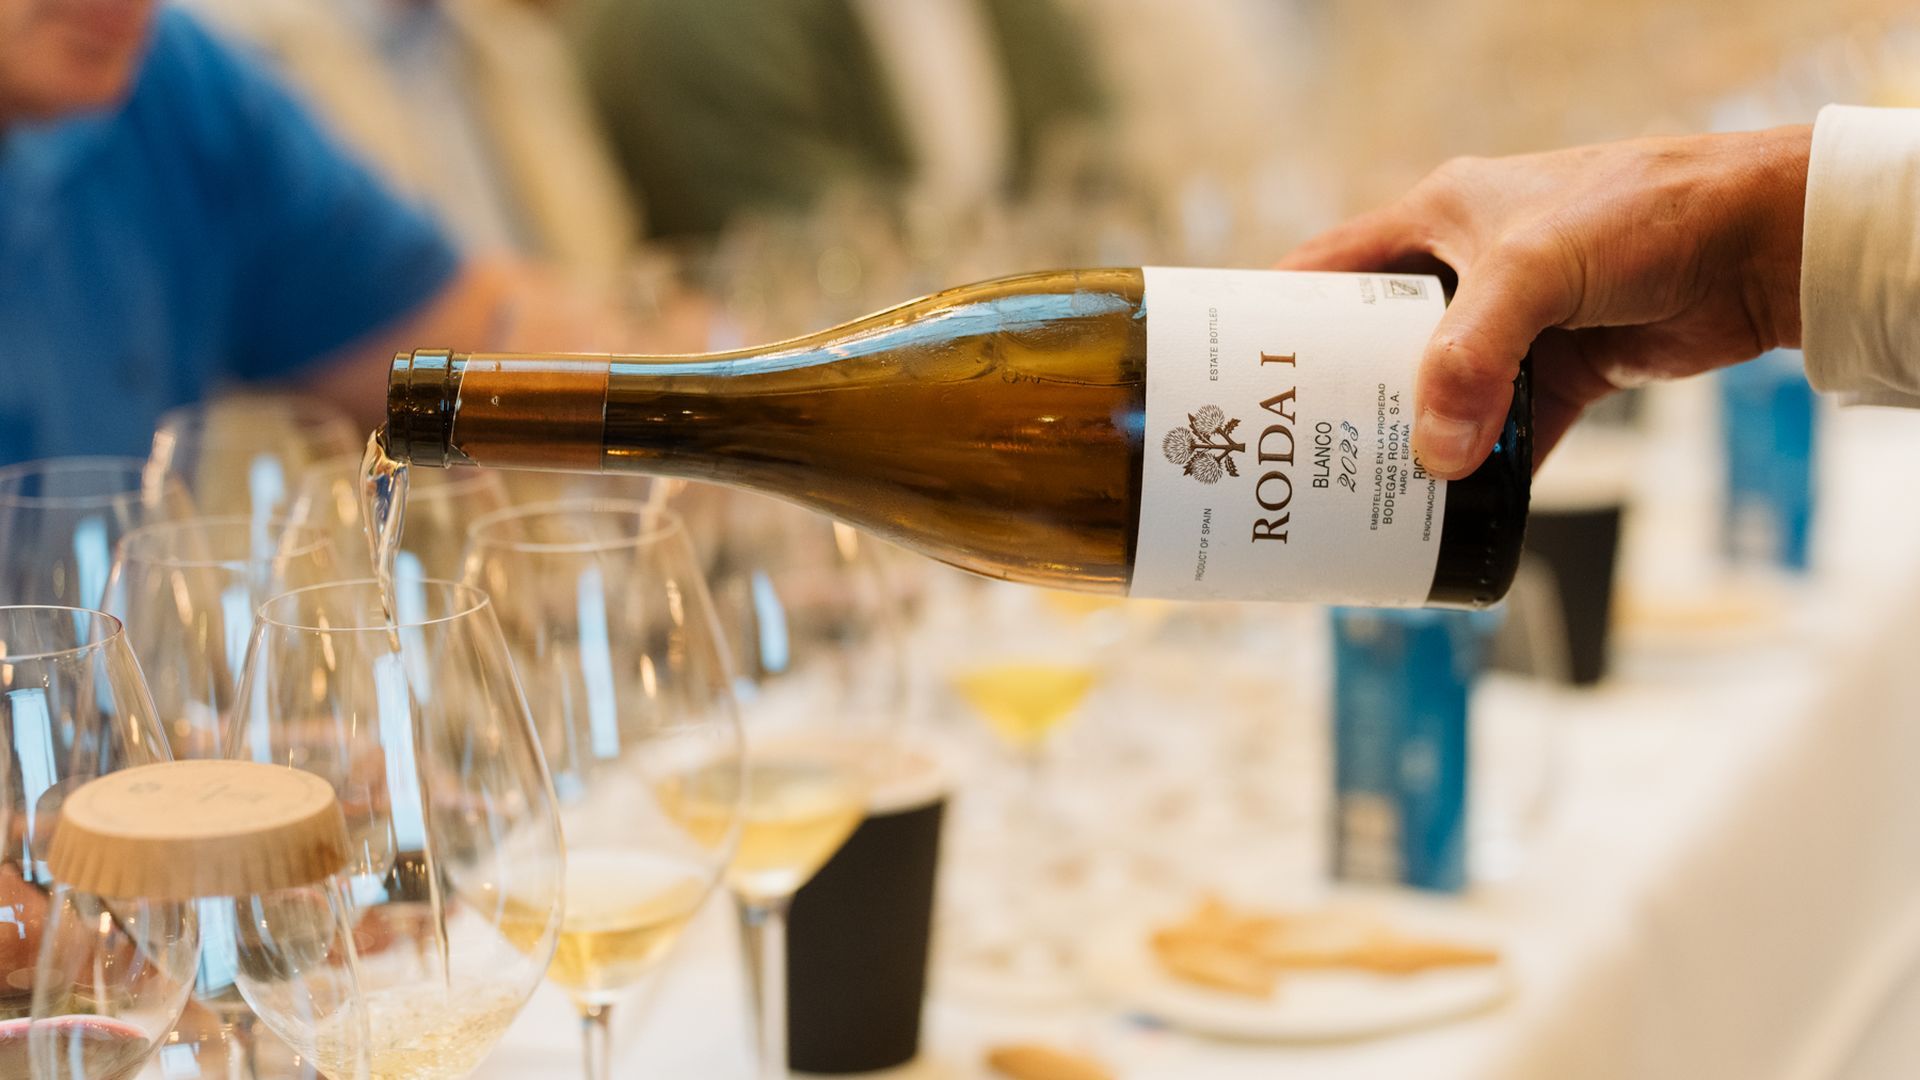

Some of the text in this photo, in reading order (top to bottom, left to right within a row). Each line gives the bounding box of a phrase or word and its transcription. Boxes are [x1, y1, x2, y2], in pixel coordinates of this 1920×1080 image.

[1209, 307, 1218, 381] ESTATE BOTTLED
[1251, 351, 1296, 544] RODA I
[1312, 422, 1332, 488] BLANCO
[1337, 420, 1359, 493] 2023
[1369, 383, 1385, 531] EMBOTELLADO EN LA PROPIEDAD
[1383, 391, 1400, 525] BODEGAS RODA, S.A.
[1400, 424, 1410, 460] ESPAÑA
[1399, 469, 1408, 495] HARO
[1422, 479, 1436, 542] DENOMINACIÓN
[1195, 508, 1212, 581] PRODUCT OF SPAIN
